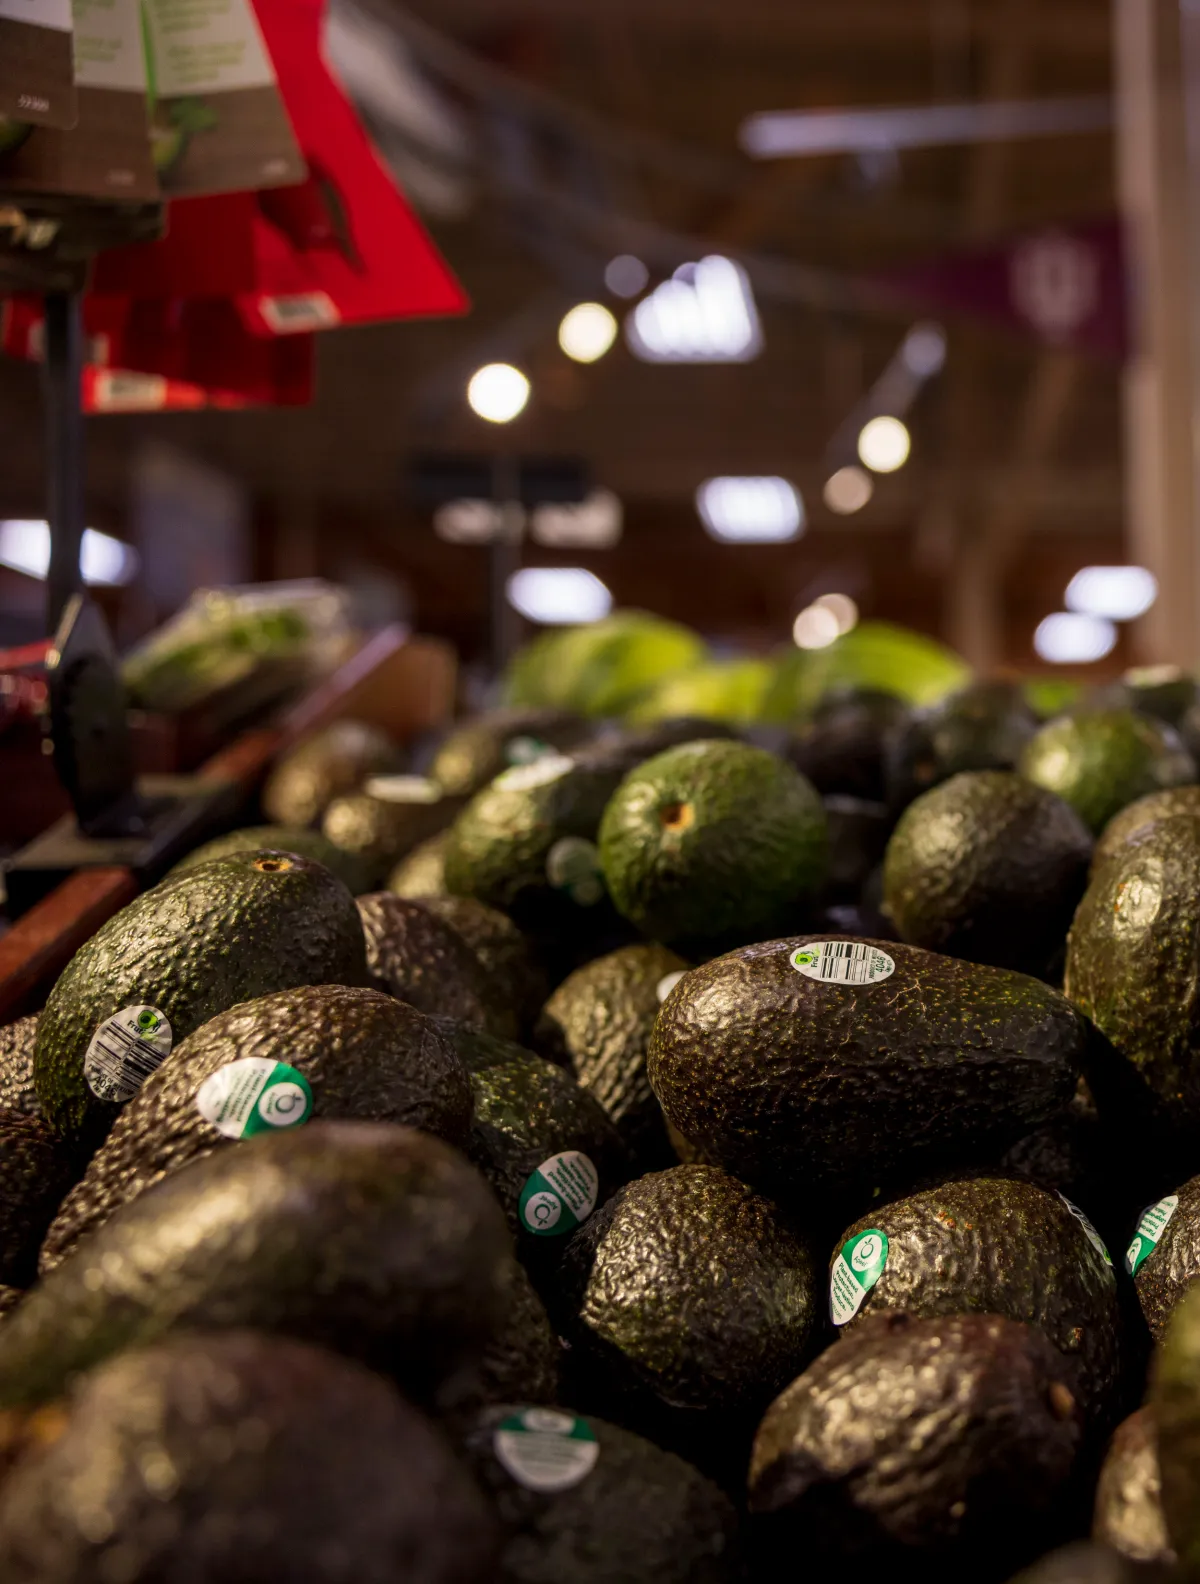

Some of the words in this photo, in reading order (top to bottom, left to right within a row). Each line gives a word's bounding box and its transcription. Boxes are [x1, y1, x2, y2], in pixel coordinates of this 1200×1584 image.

[876, 956, 886, 973] 4046
[95, 1076, 116, 1096] 4046
[839, 1262, 859, 1293] Plant-based
